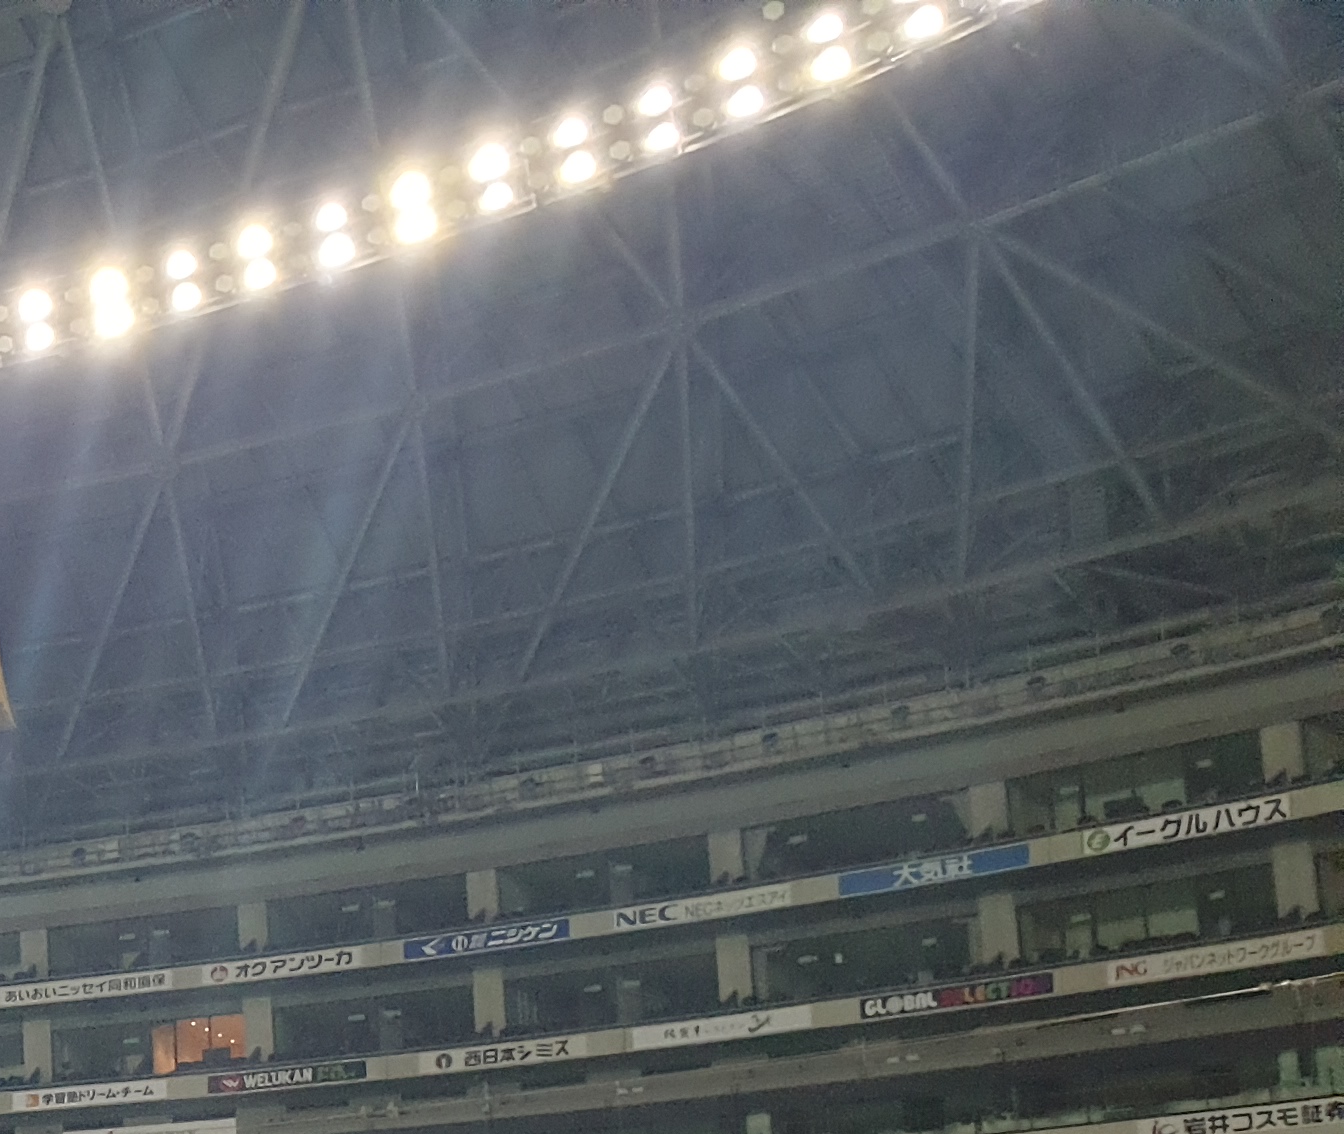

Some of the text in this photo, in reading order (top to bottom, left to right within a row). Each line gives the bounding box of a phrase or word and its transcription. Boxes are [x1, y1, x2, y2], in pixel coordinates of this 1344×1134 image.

[1113, 798, 1287, 846] イーグルハウス
[893, 856, 972, 887] 大気社
[616, 904, 679, 927] NEC
[235, 951, 354, 977] オクアンツーカ
[243, 1067, 313, 1088] WELUKAN
